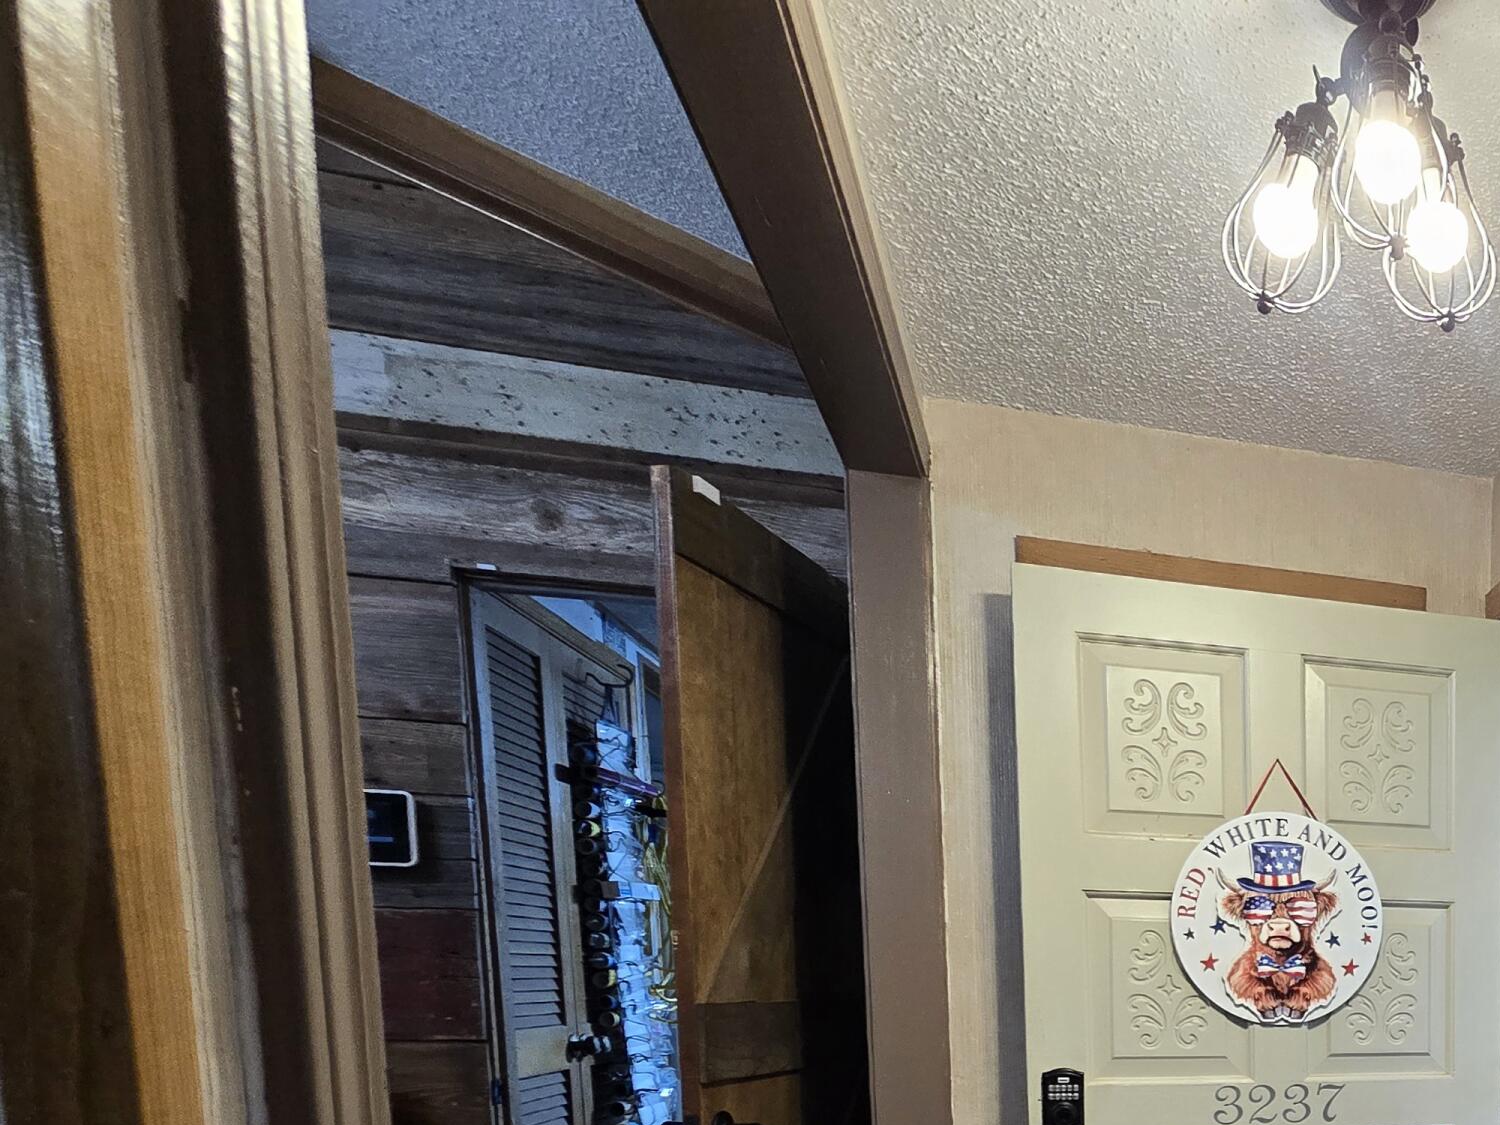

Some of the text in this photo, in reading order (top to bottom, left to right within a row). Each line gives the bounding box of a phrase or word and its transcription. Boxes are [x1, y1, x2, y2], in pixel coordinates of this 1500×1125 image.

[1177, 818, 1378, 929] RED, WHITE AND MOO!
[1213, 1083, 1346, 1125] 3237
